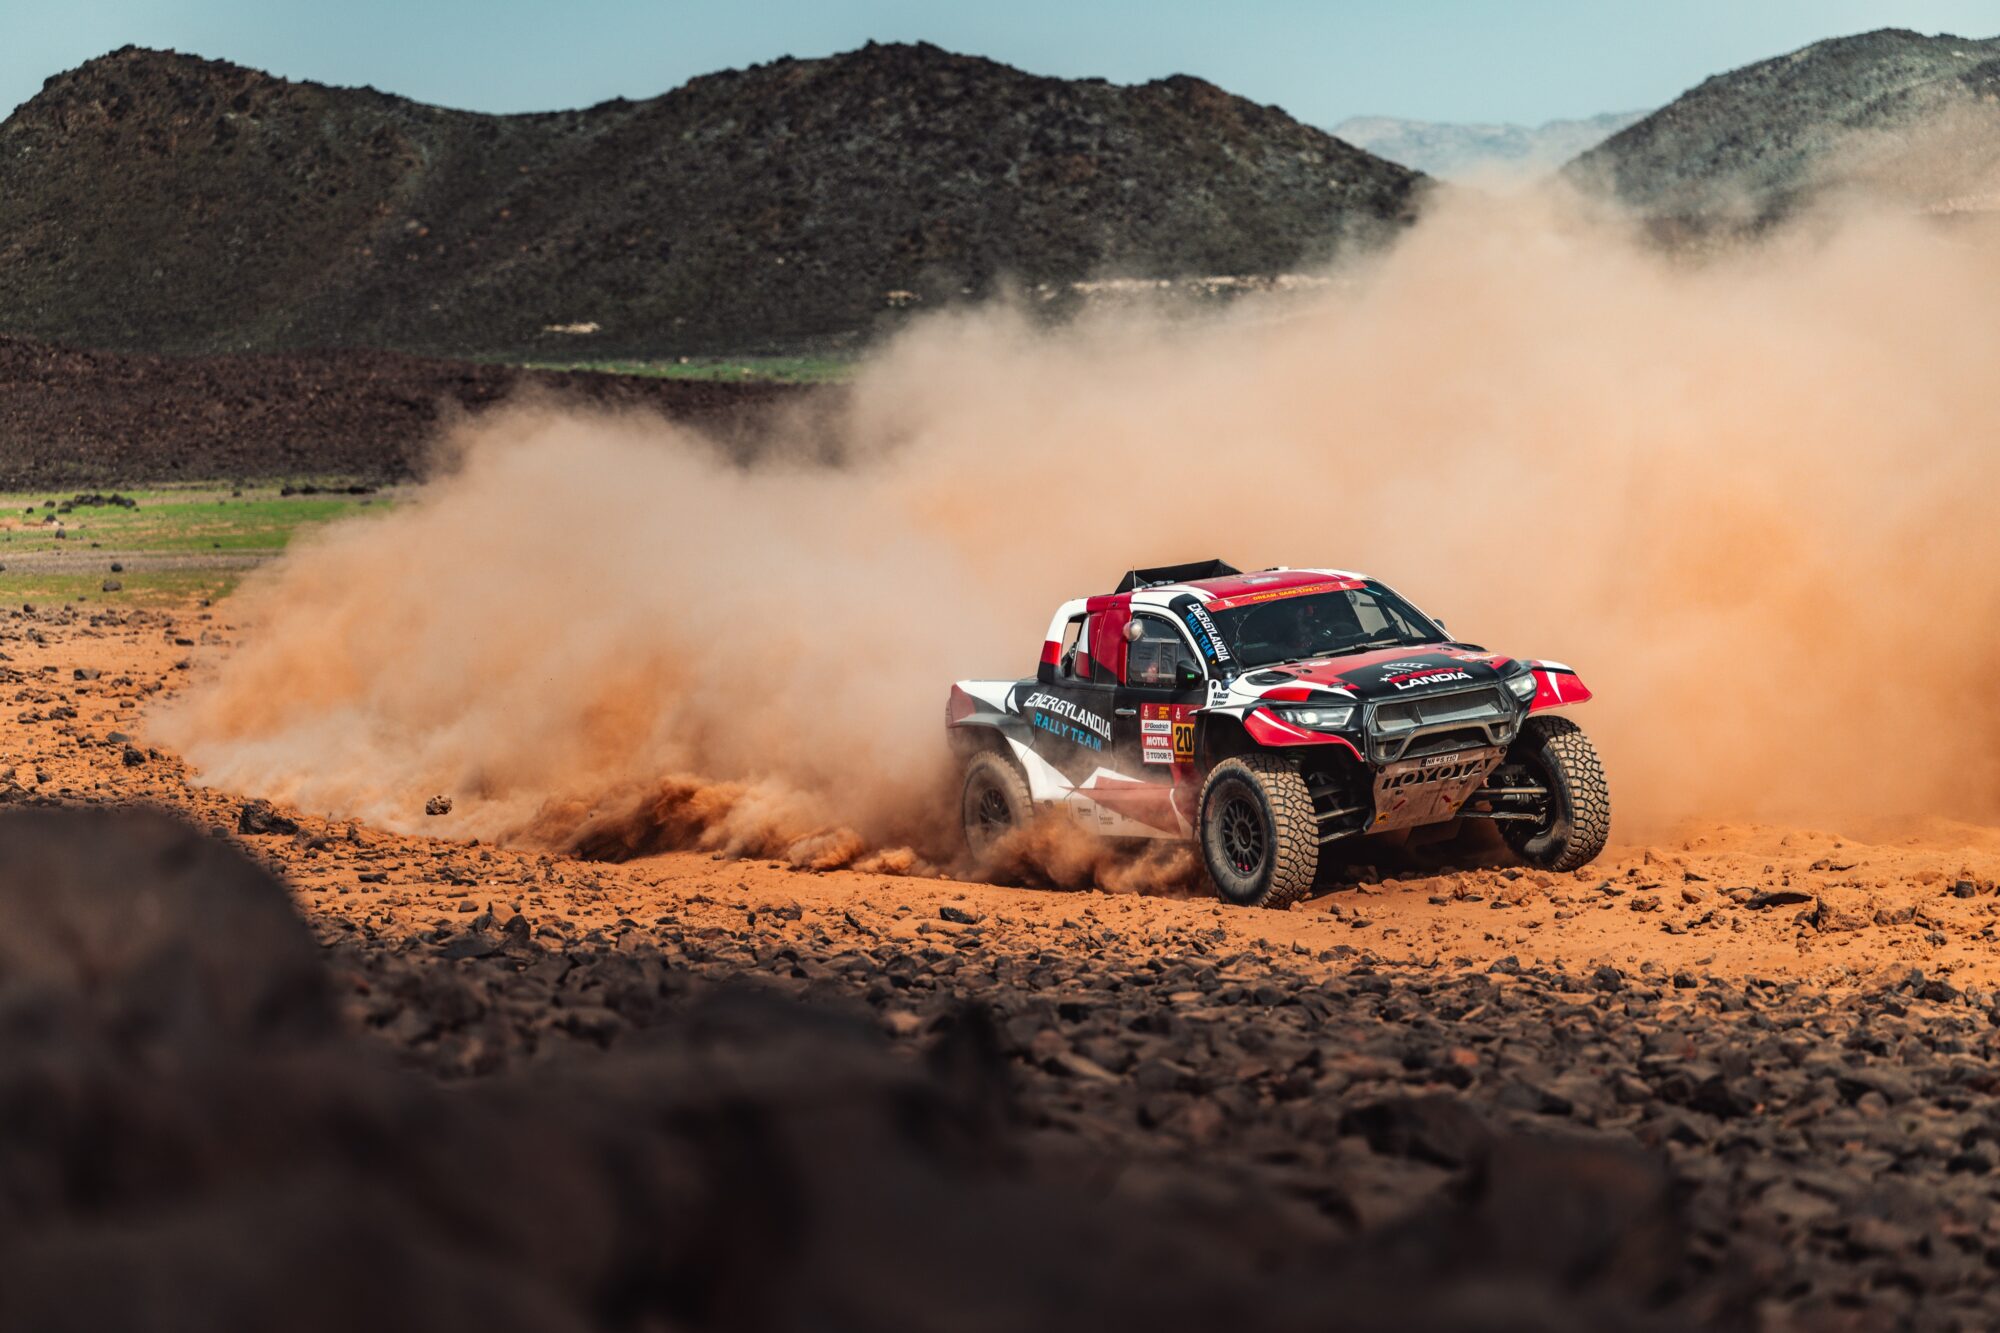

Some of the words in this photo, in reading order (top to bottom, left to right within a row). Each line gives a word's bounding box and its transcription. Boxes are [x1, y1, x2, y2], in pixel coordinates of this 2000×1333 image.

[1185, 612, 1203, 636] RALLY
[1199, 634, 1216, 658] TEAM
[1187, 603, 1230, 662] ENERGYLANDIA
[1394, 672, 1473, 690] LANDIA
[1023, 692, 1111, 741] ENERGYLANDIA
[1034, 711, 1069, 737] RALLY
[1071, 727, 1102, 752] TEAM
[1146, 736, 1169, 746] MOTUL
[1175, 725, 1195, 753] 20
[1150, 752, 1168, 760] TUDOR
[1382, 758, 1493, 790] TOYOTA
